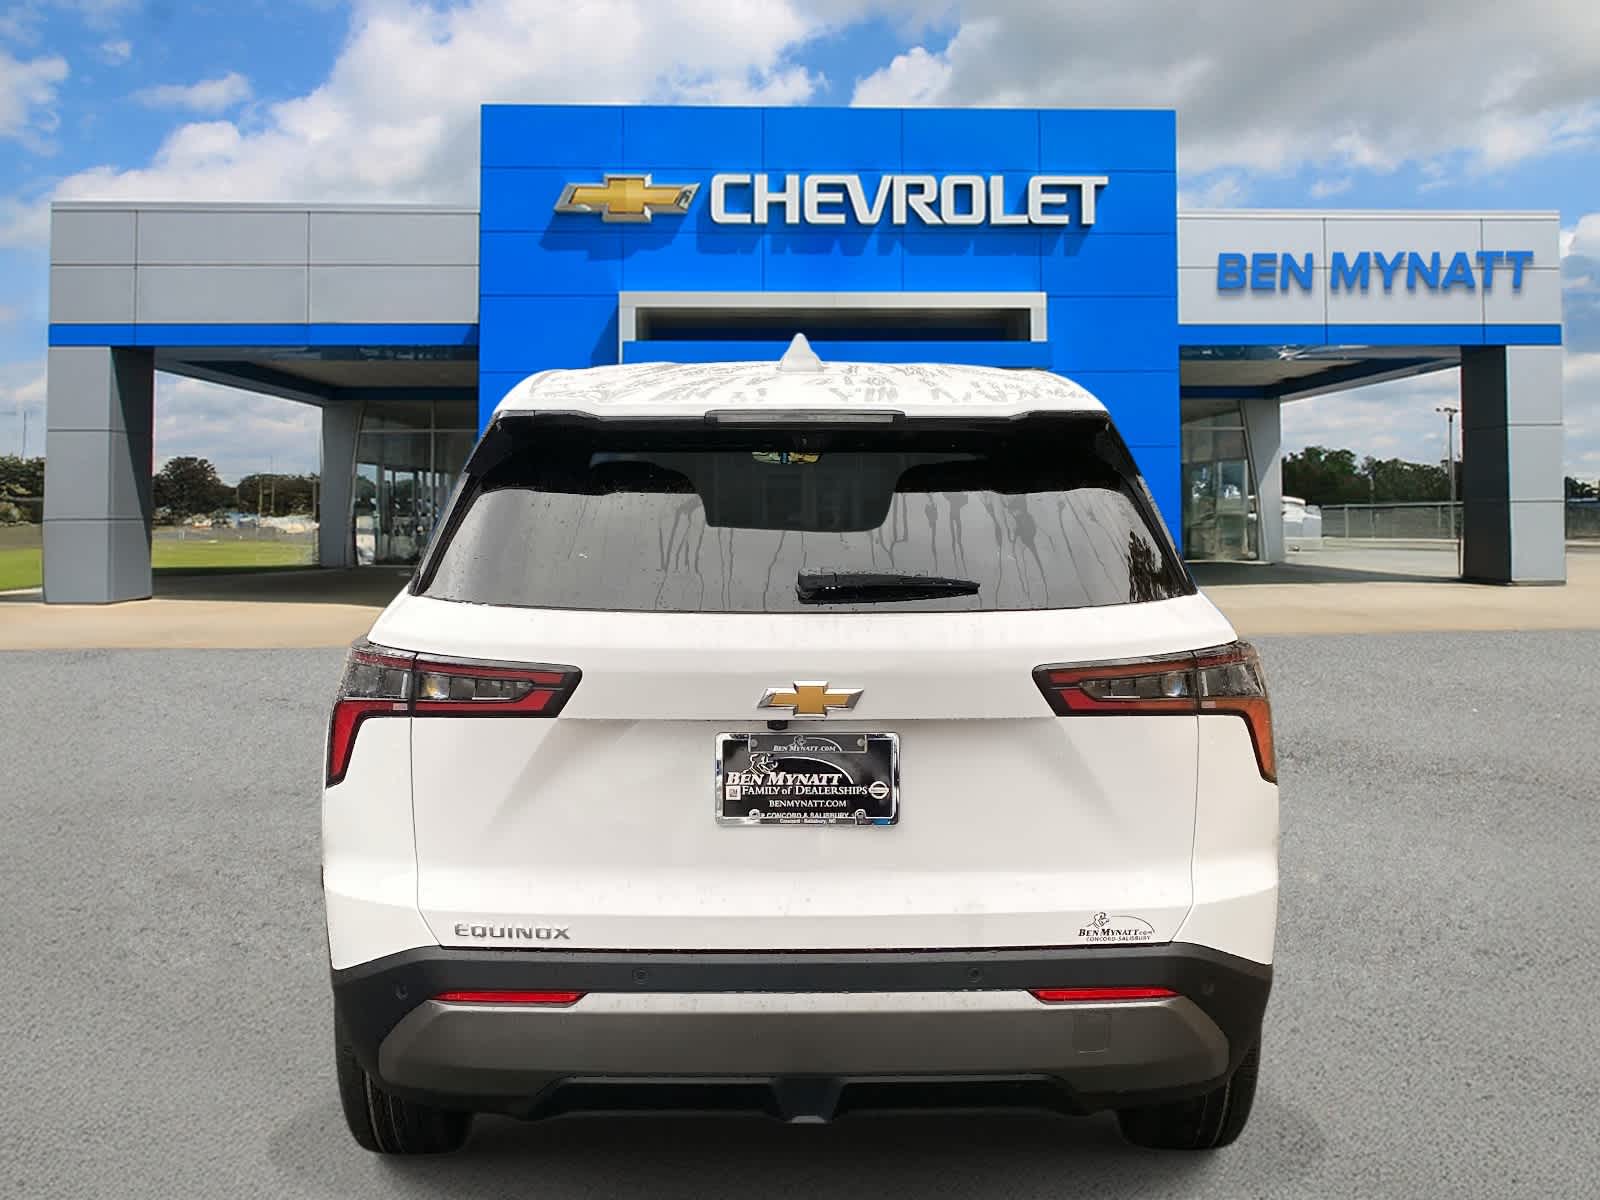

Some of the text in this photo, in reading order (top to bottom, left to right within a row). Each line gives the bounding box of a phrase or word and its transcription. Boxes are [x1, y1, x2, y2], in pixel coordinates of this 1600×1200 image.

[710, 173, 1109, 225] CHEVROLET
[1217, 250, 1534, 290] BEN MYNATT
[726, 771, 842, 786] BEN MYNATT
[742, 785, 780, 795] FAMILY
[781, 786, 792, 795] of
[795, 785, 868, 795] DEALERSHIPS
[768, 799, 847, 808] BENMYNATT.COM
[454, 923, 570, 940] EQUINOX
[1078, 928, 1099, 937] BEN
